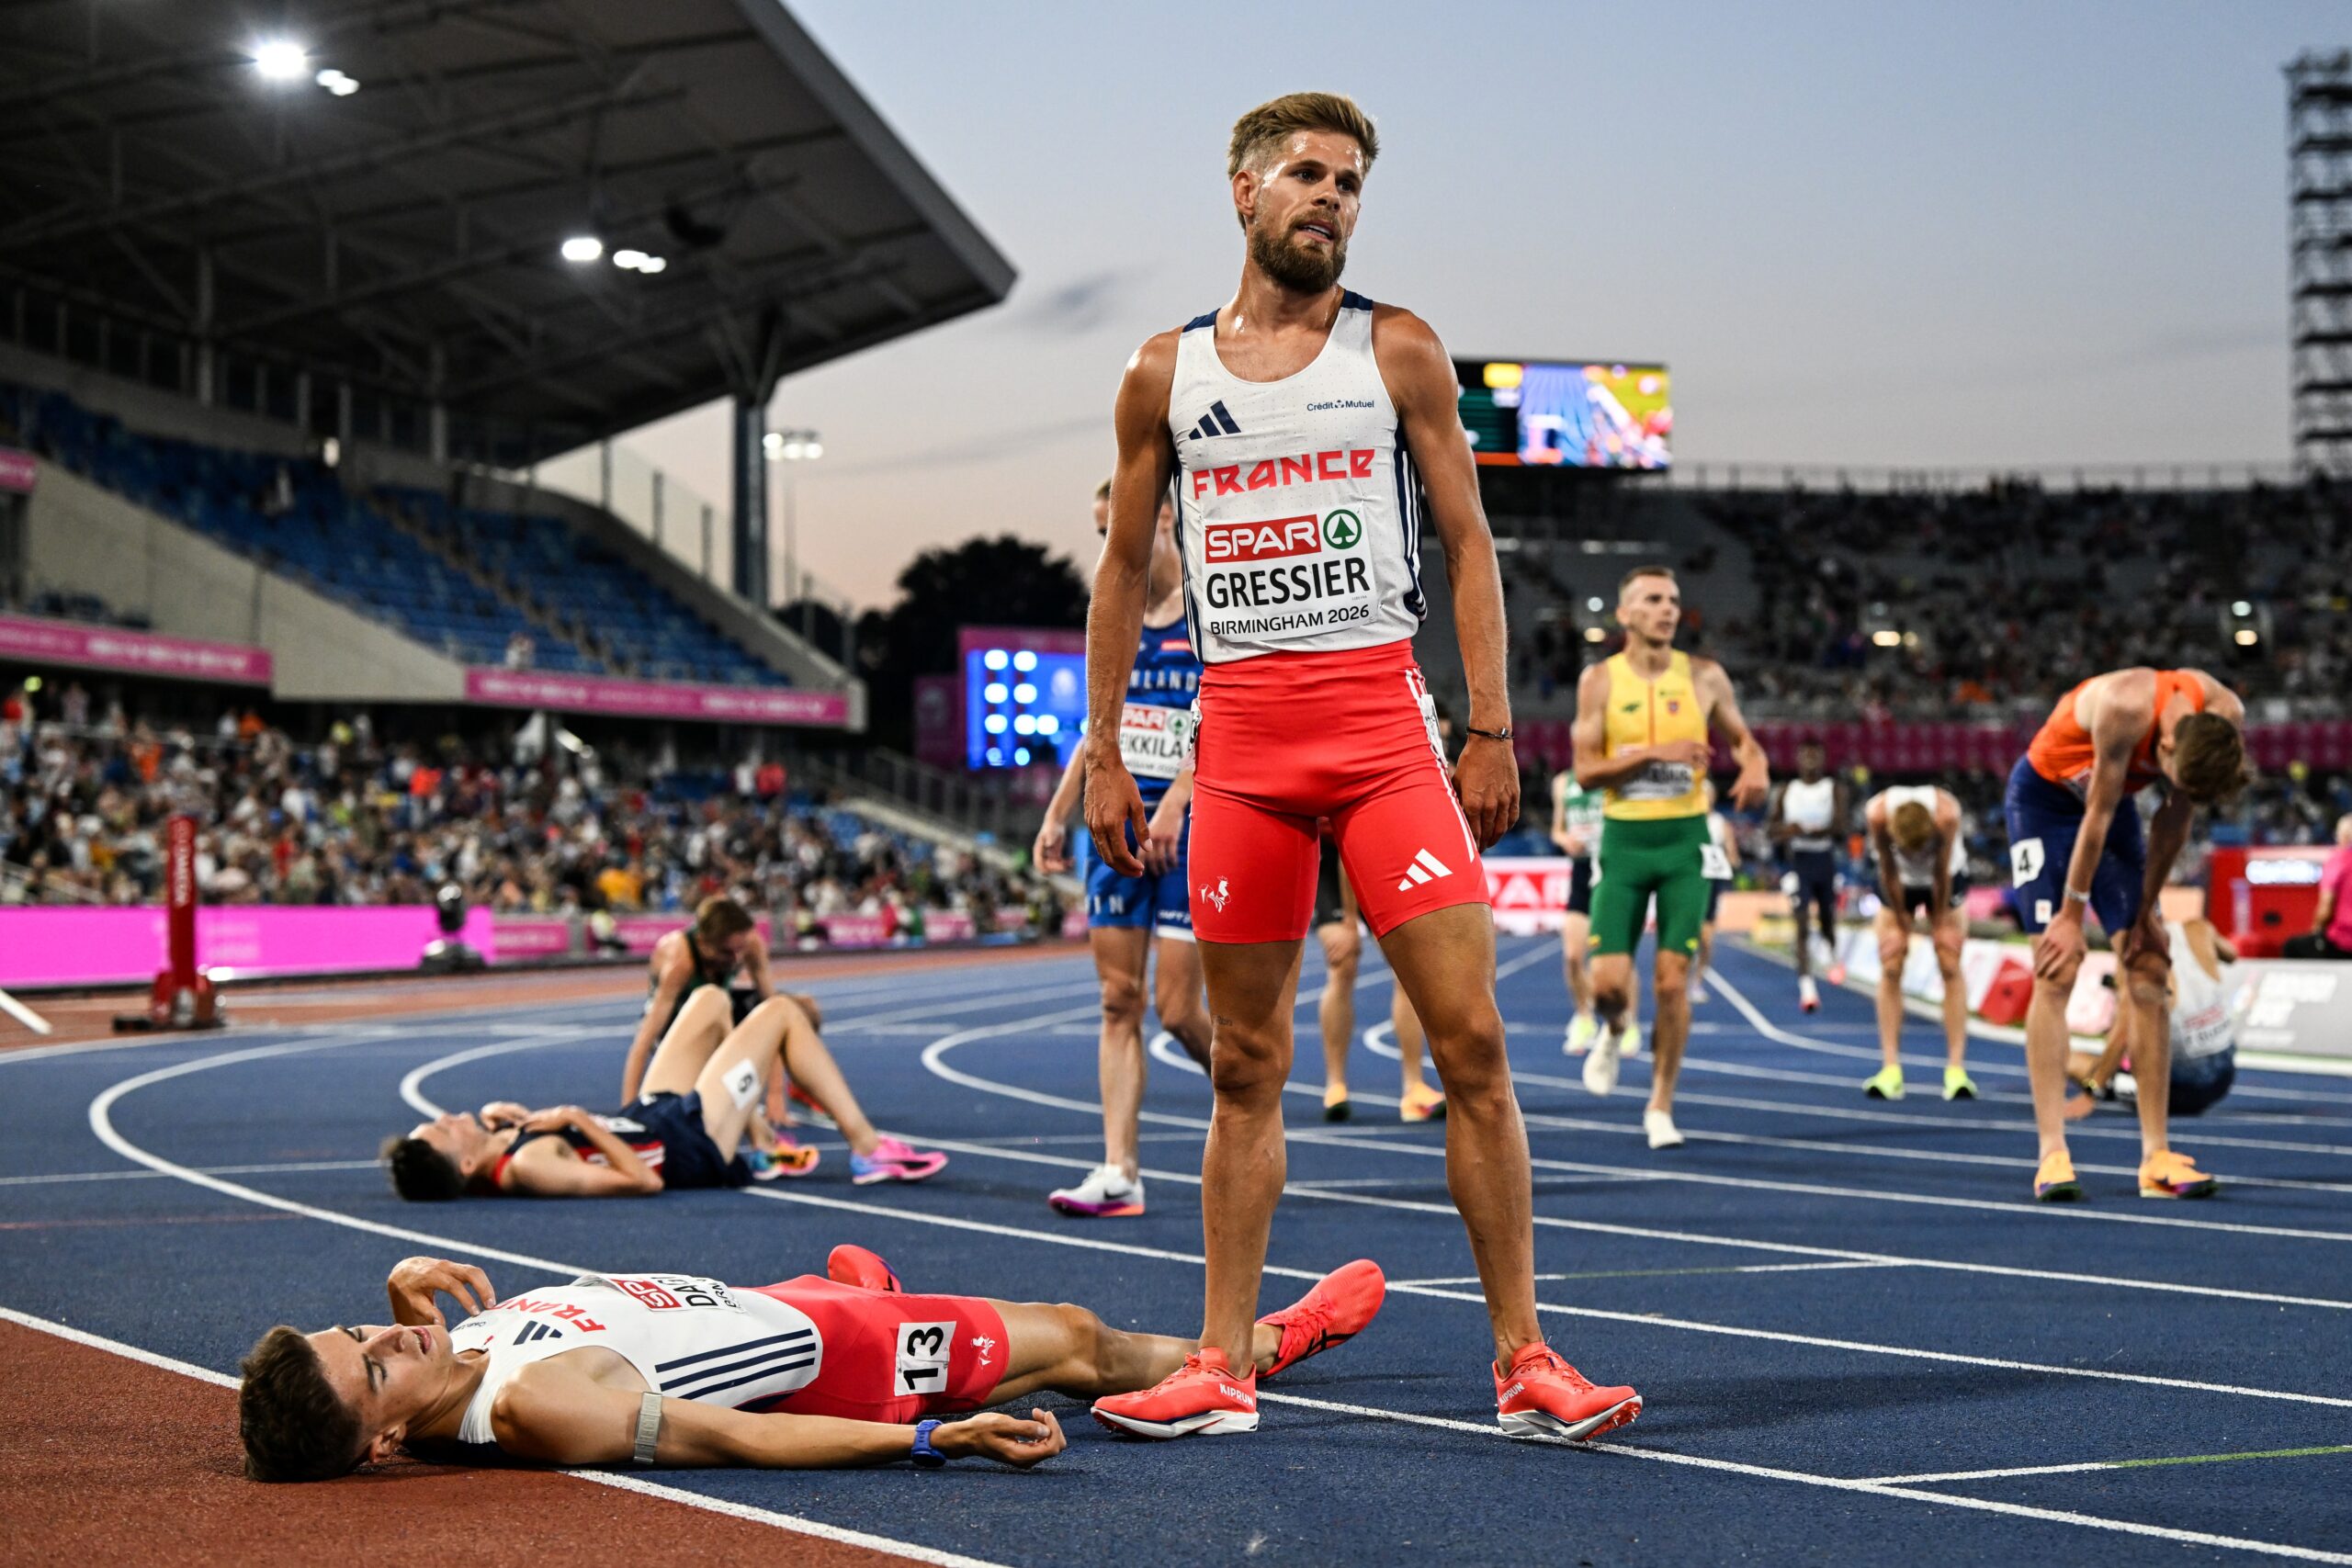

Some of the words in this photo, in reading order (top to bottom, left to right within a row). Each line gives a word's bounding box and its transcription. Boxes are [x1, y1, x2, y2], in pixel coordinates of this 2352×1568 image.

[1306, 401, 1334, 412] Crédit
[1345, 400, 1374, 409] Mutuel
[1193, 448, 1374, 500] FRANCE
[1208, 521, 1317, 558] SPAR
[1206, 557, 1371, 609] GRESSIER
[1211, 612, 1324, 635] BIRMINGHAM
[1328, 604, 1369, 624] 2026
[2018, 848, 2033, 874] 4
[903, 1326, 944, 1391] 13
[1219, 1382, 1254, 1407] KIPRUN
[1498, 1382, 1525, 1406] KIPRUN
